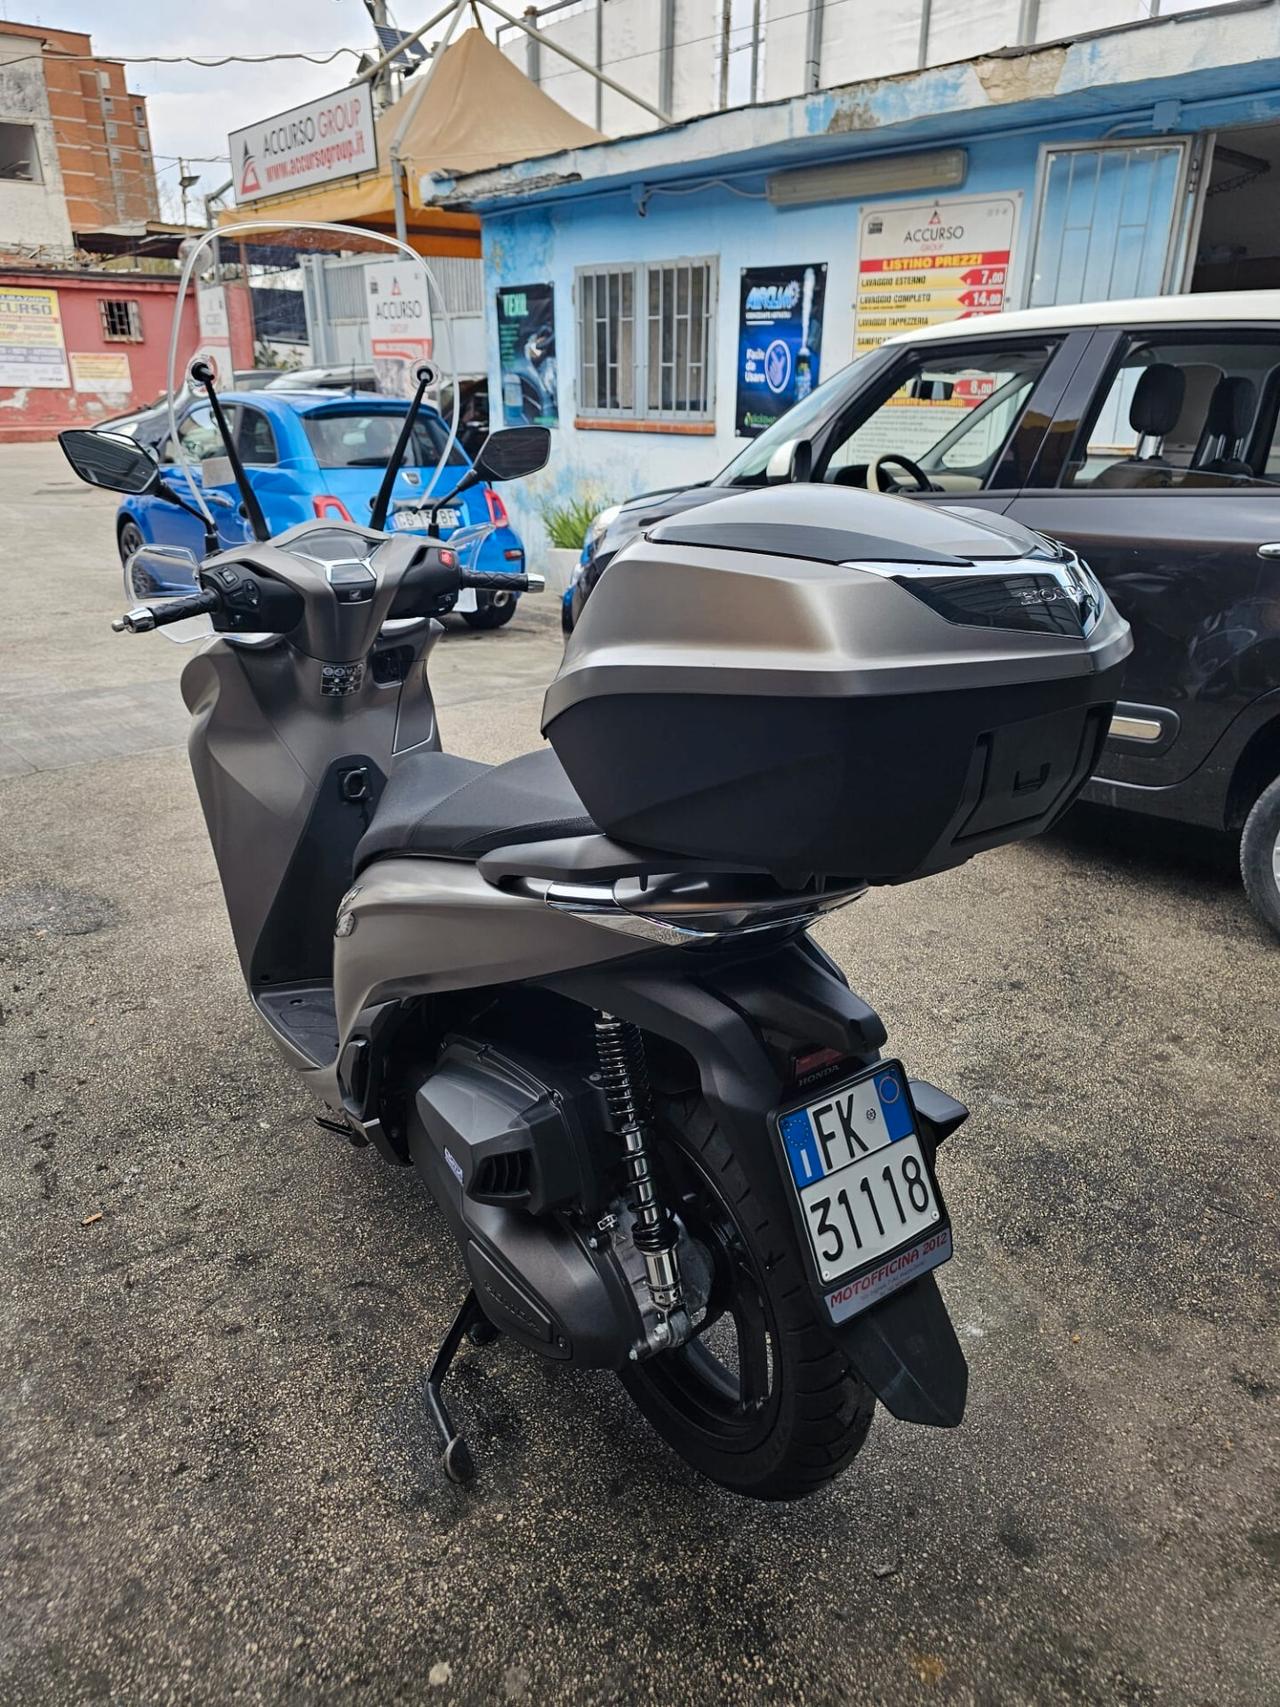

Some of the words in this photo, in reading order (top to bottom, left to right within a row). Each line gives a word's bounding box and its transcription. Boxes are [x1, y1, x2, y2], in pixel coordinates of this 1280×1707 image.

[263, 117, 316, 159] ACCURSO
[318, 99, 362, 138] GROUP
[267, 130, 366, 183] www.accursogroup.it
[904, 225, 965, 243] ACCURSO
[882, 257, 932, 272] LISTINO
[934, 253, 984, 269] PREZZI
[861, 277, 893, 287] LAVAGGIO
[895, 275, 926, 286] ESTERNO
[981, 270, 1004, 285] 7,00
[859, 295, 892, 305] LAVAGGIO
[893, 293, 931, 303] COMPLETO
[973, 291, 1001, 306] 14,00
[376, 300, 422, 320] ACCURSO
[858, 317, 887, 328] LAVAGGIO
[889, 316, 928, 326] TAPPEZZERIA
[799, 1064, 840, 1087] HONDA
[812, 1094, 869, 1170] FK
[810, 1155, 929, 1262] 31118
[830, 1248, 920, 1308] MOTOFFICINA
[922, 1232, 948, 1256] 2012
